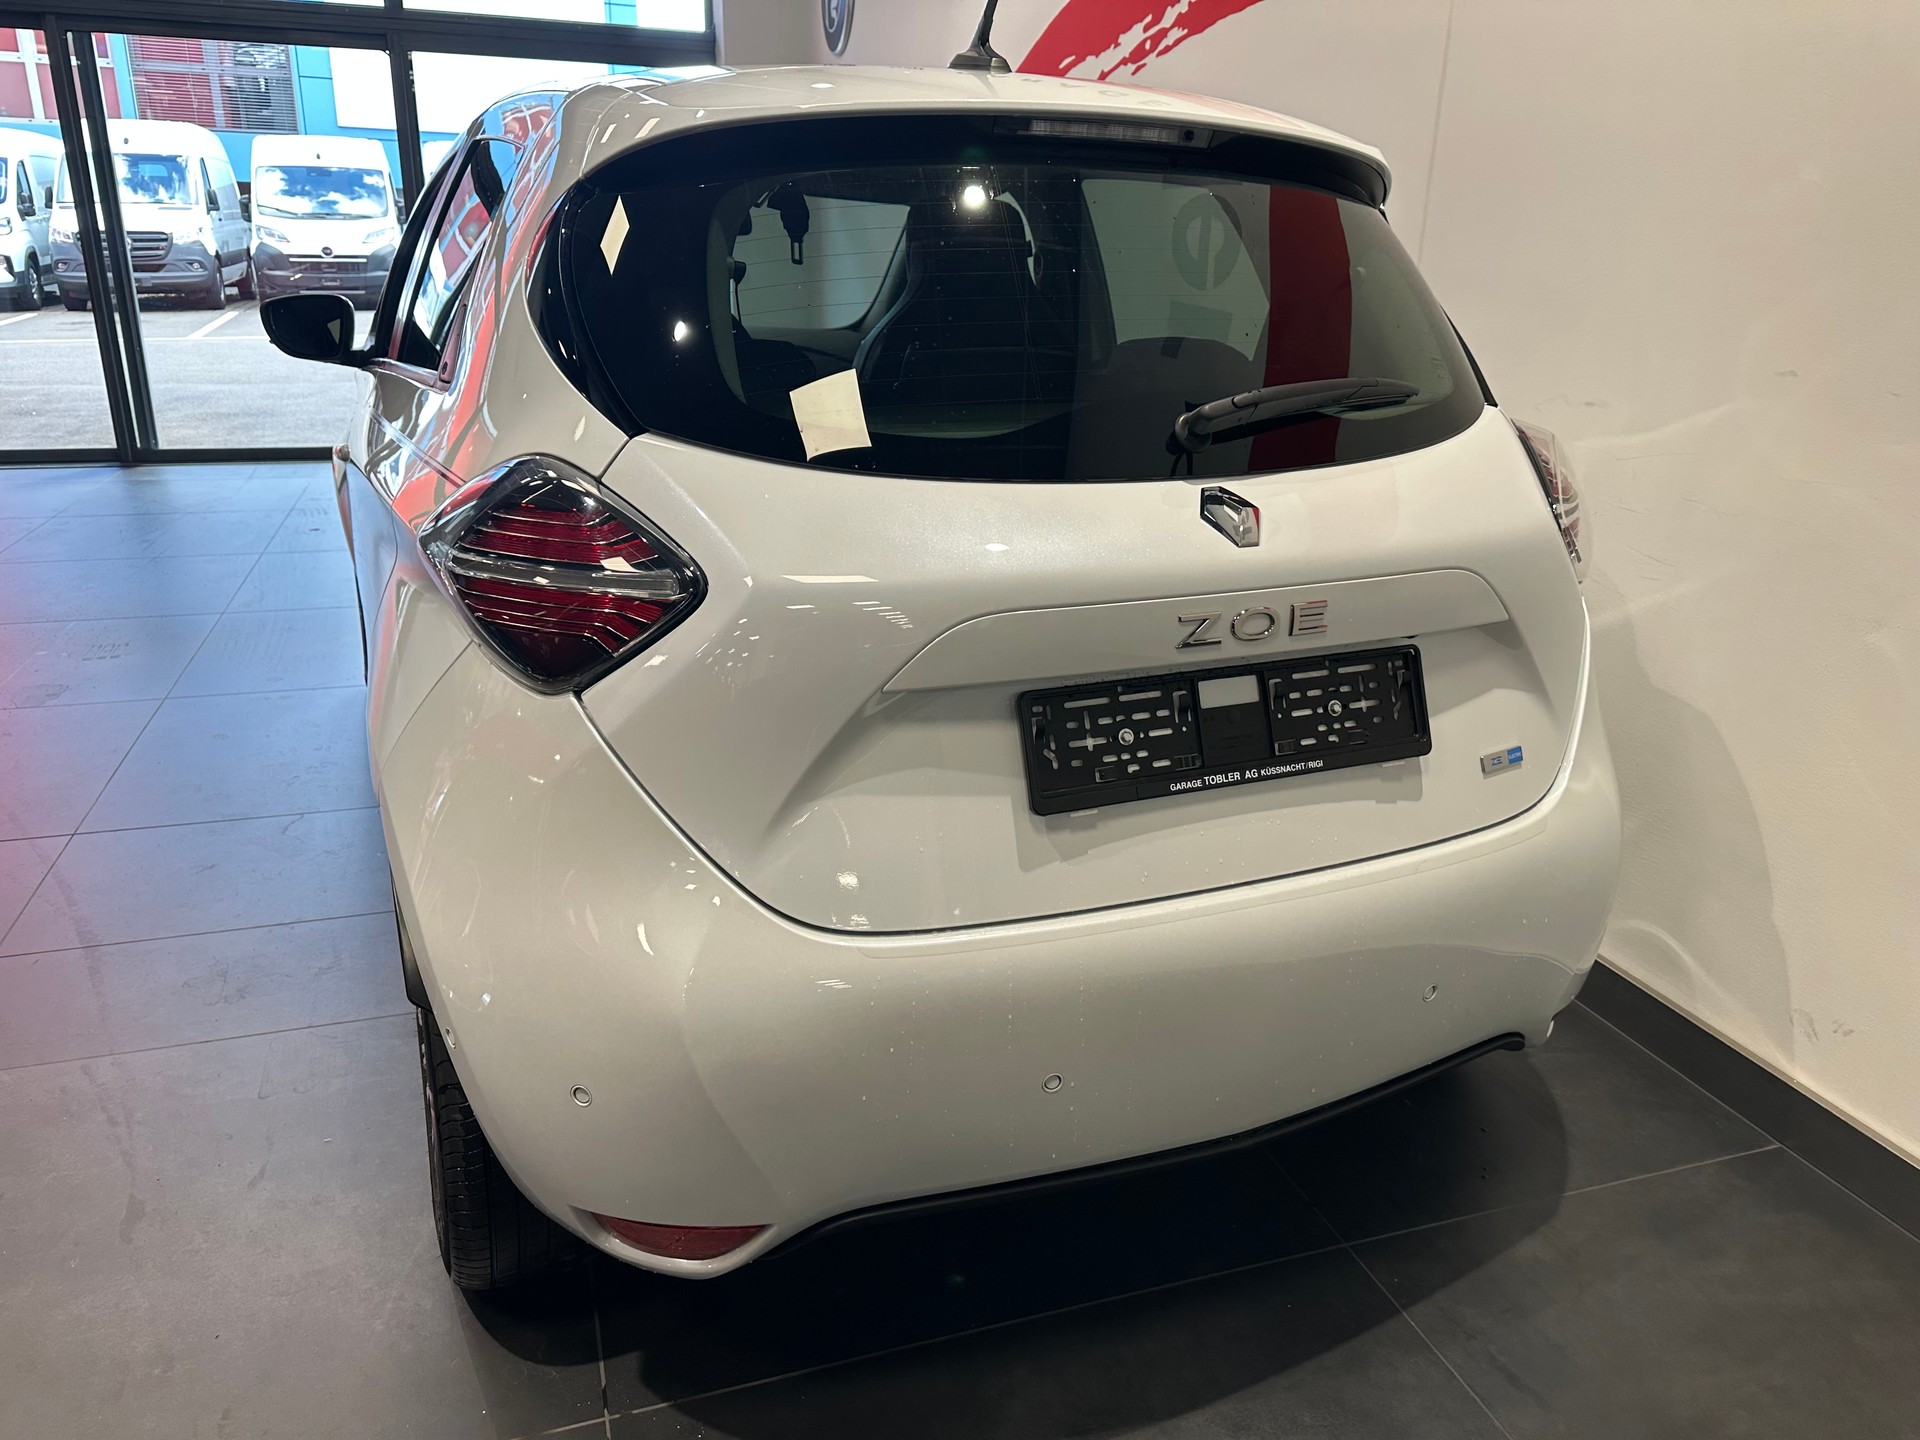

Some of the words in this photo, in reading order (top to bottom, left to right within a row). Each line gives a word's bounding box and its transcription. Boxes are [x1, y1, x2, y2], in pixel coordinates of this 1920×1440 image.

[1175, 600, 1328, 649] ZOE
[1170, 779, 1202, 791] GARAGE
[1204, 771, 1241, 786] TOBLER
[1244, 769, 1258, 780] AG
